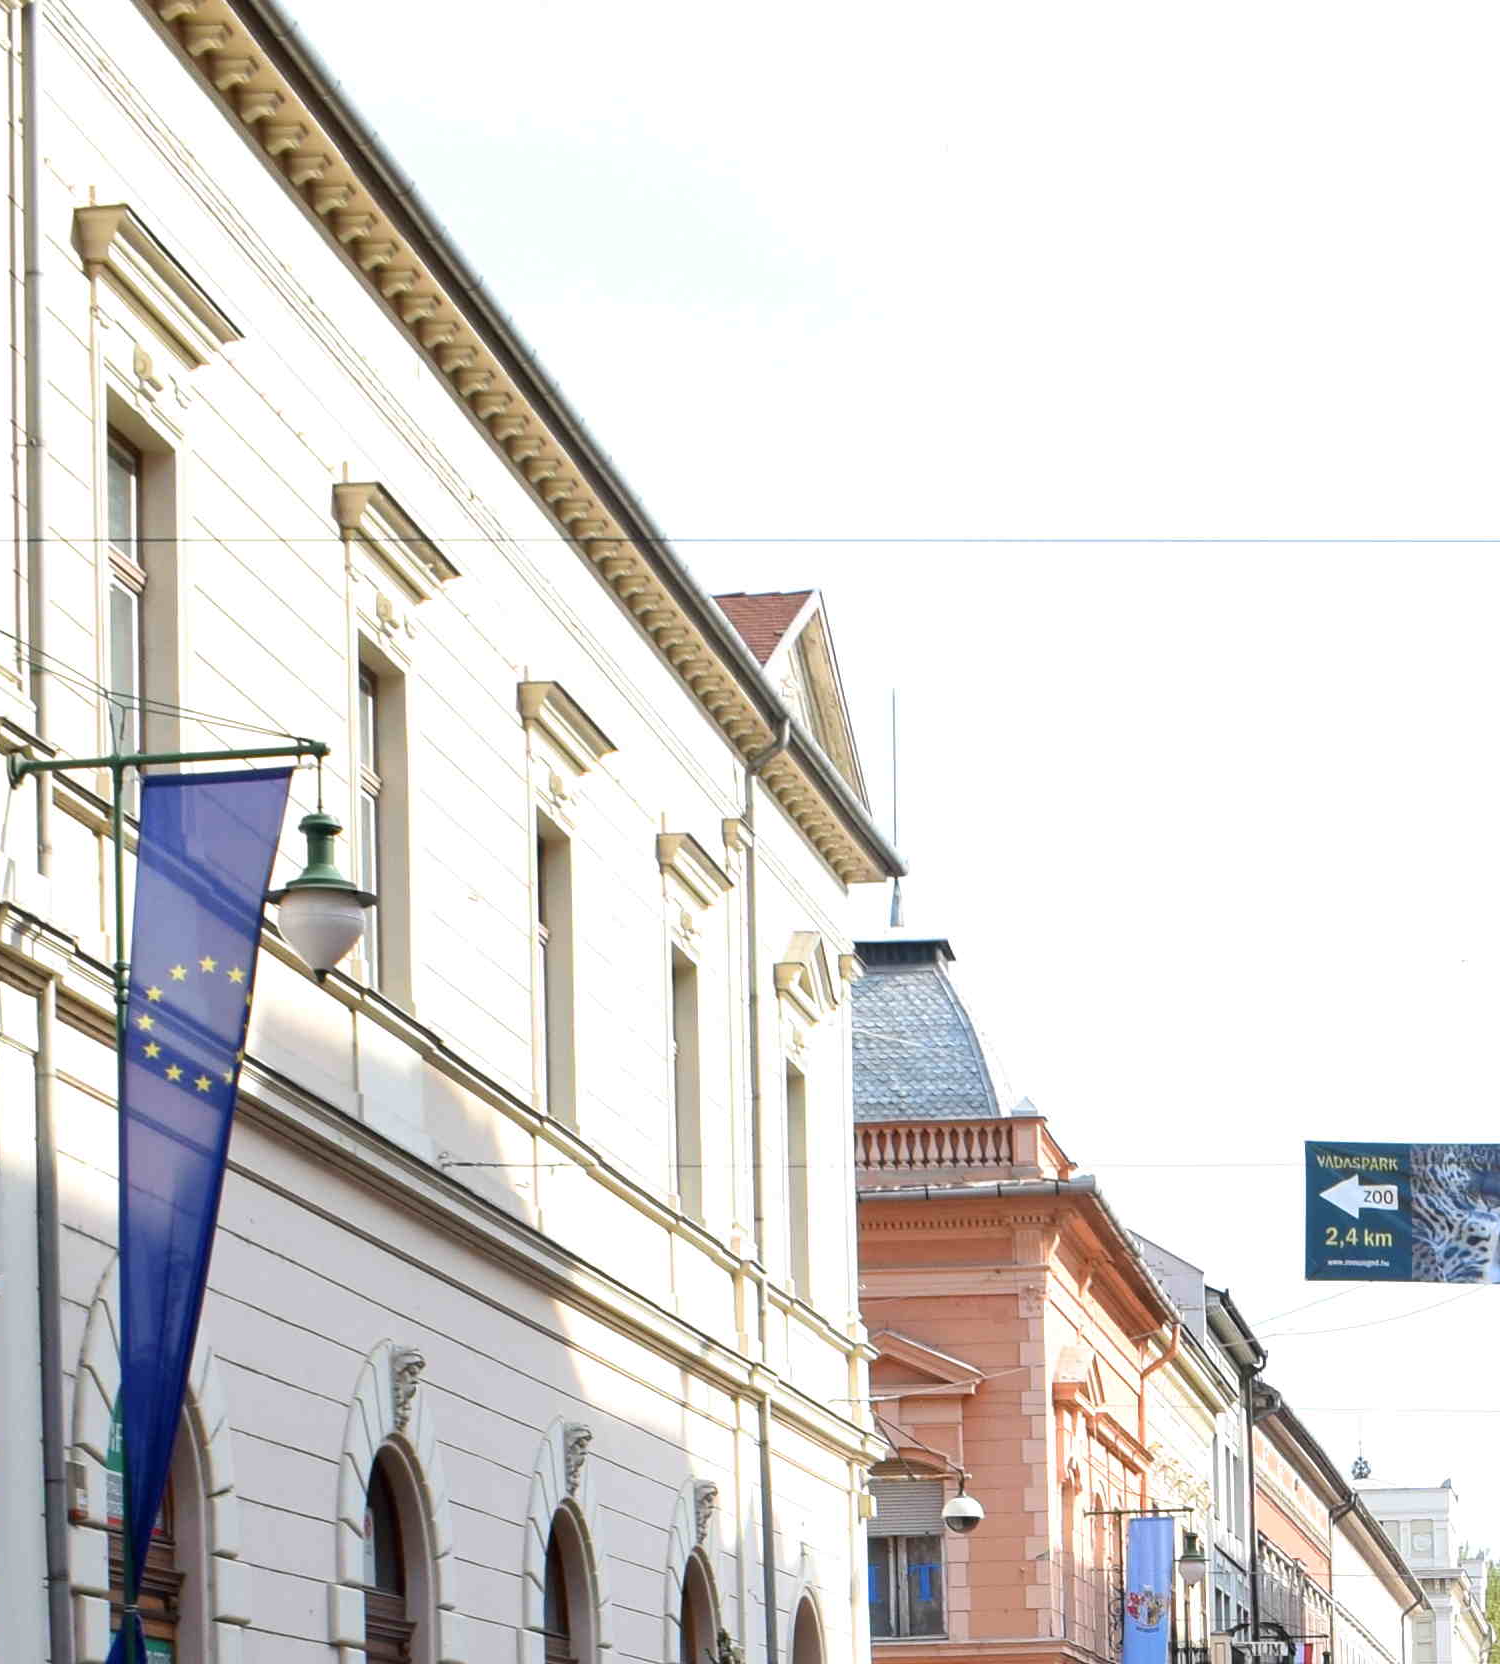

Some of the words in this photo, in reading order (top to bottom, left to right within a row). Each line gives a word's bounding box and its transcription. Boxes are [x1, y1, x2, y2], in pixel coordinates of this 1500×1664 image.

[1364, 1190, 1393, 1204] ZOO
[1325, 1226, 1358, 1248] 2,4
[1364, 1229, 1392, 1247] km
